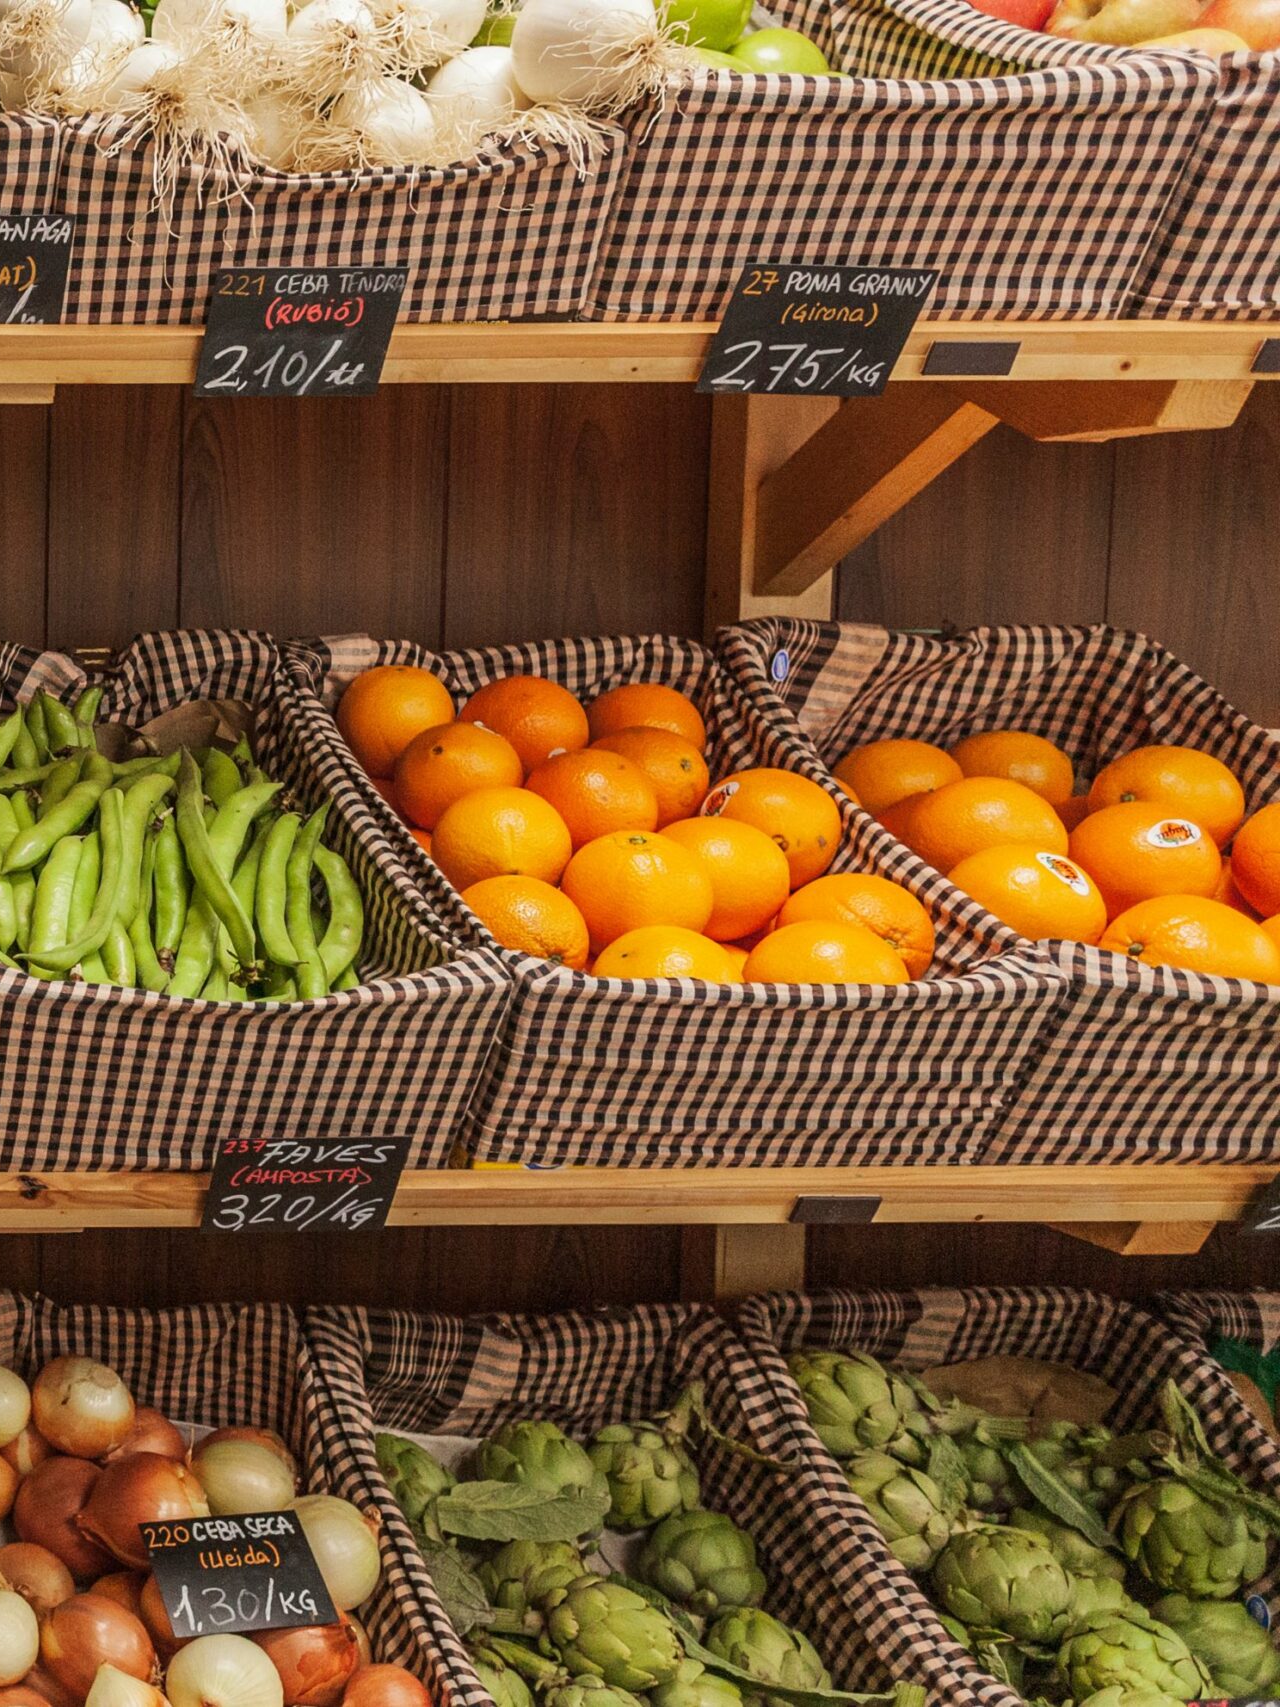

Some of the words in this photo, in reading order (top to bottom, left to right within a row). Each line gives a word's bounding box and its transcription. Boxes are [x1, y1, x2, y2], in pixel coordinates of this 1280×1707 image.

[218, 274, 266, 296] 221
[274, 272, 330, 294] CEBA
[742, 270, 780, 294] 27
[783, 271, 841, 295] POMA
[849, 273, 933, 297] GRANNY
[781, 302, 879, 327] (Girona)
[223, 1140, 267, 1154] 237
[258, 1141, 396, 1166] FAVES
[144, 1525, 190, 1548] 220
[192, 1519, 246, 1542] CEBA
[244, 1515, 296, 1540] SECA
